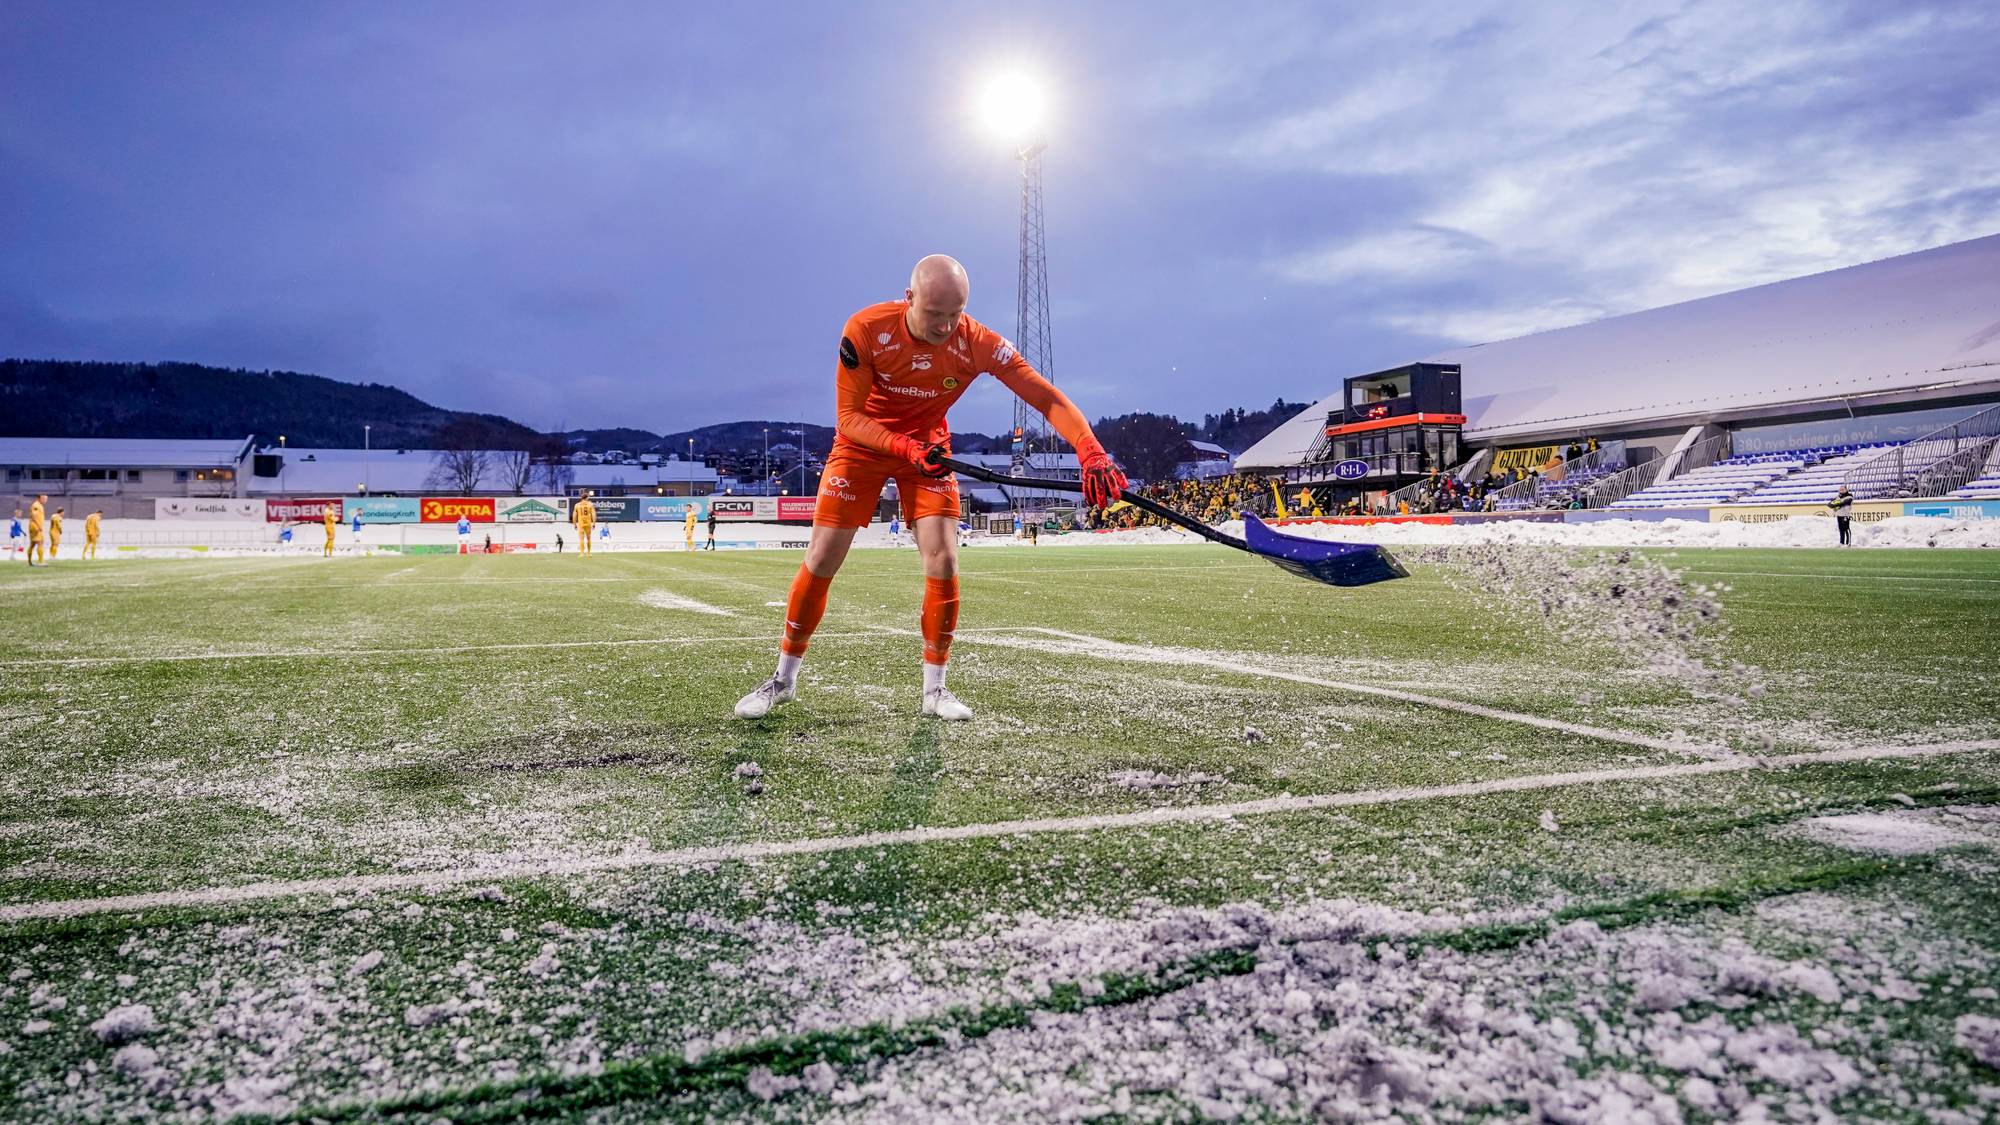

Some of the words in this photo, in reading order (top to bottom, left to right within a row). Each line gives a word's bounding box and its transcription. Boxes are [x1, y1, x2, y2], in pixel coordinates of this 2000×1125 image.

[1739, 440, 1760, 453] 380
[1765, 440, 1785, 450] nye
[1788, 432, 1828, 448] boliger
[444, 505, 492, 516] EXTRA
[715, 503, 752, 511] PCM
[1953, 506, 1983, 517] TRIM
[1740, 514, 1752, 524] OLE
